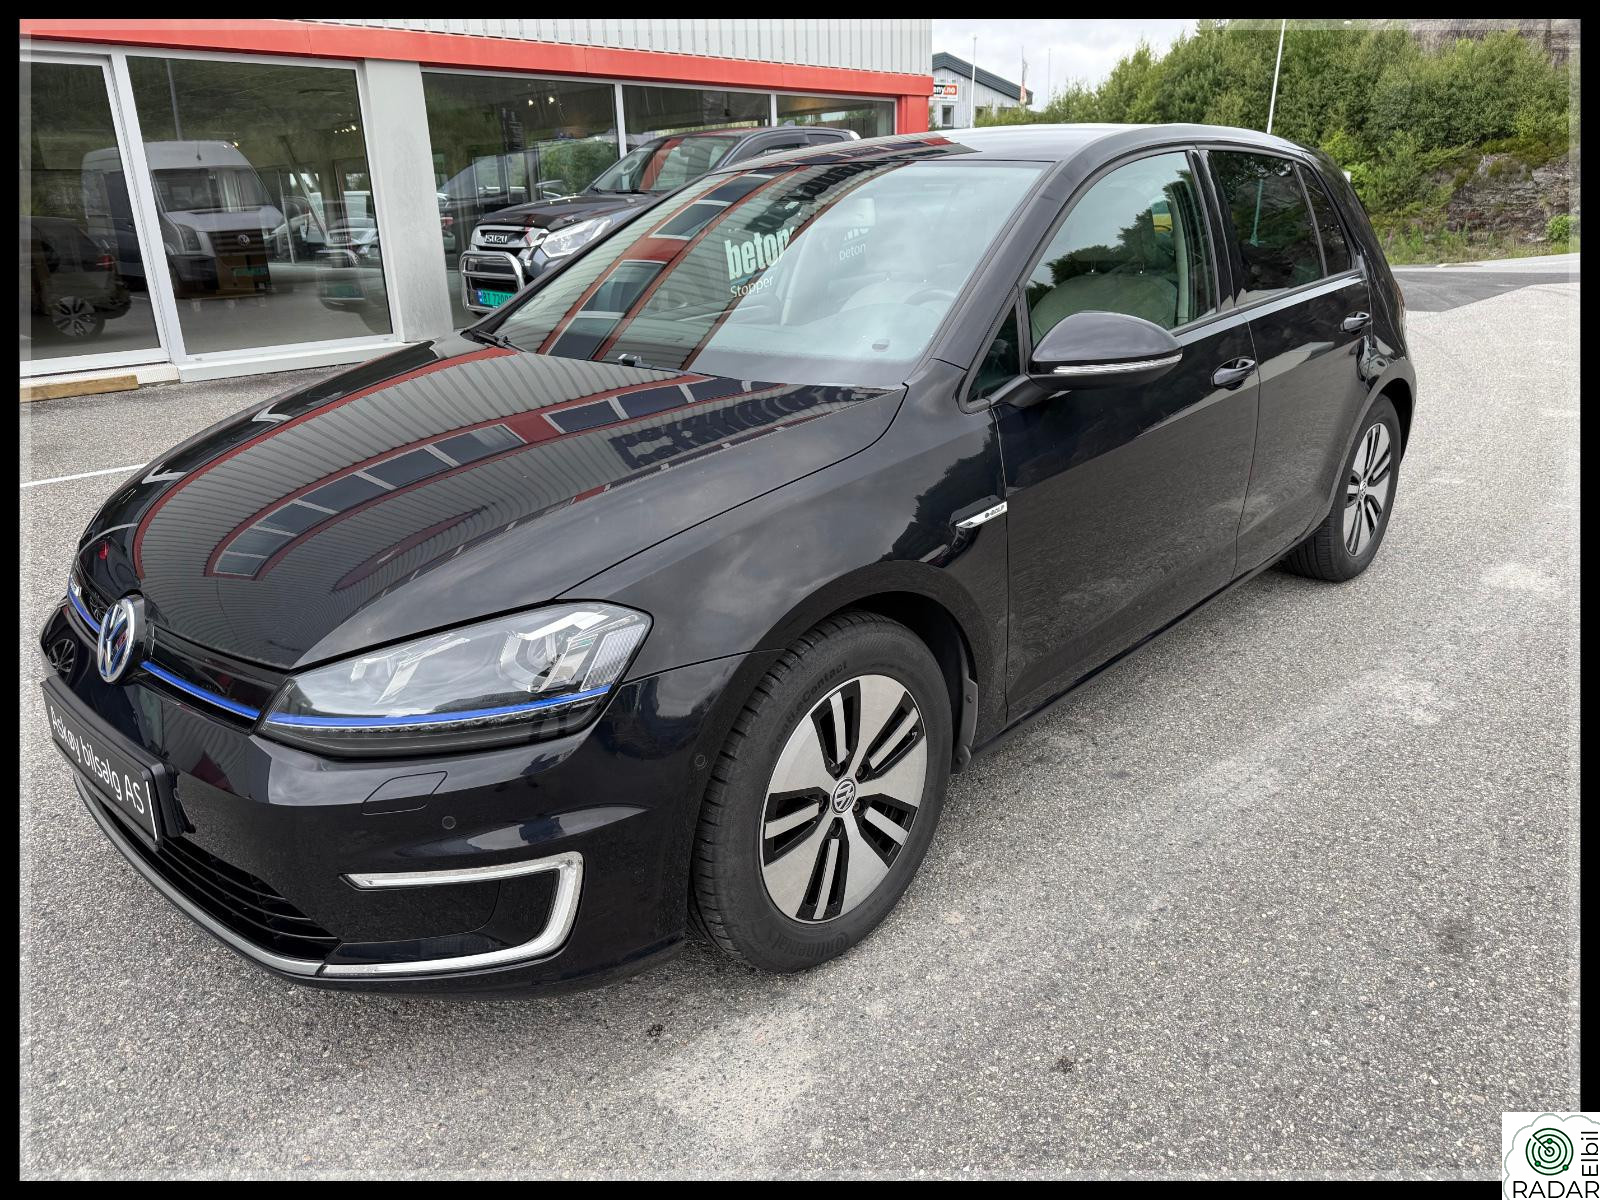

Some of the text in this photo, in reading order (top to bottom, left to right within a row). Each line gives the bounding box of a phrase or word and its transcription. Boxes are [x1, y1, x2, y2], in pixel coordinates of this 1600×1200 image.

[484, 233, 508, 244] ISUZU
[724, 226, 795, 281] beton
[730, 275, 774, 298] Stopper
[50, 705, 145, 815] Askøy bilsalg AS
